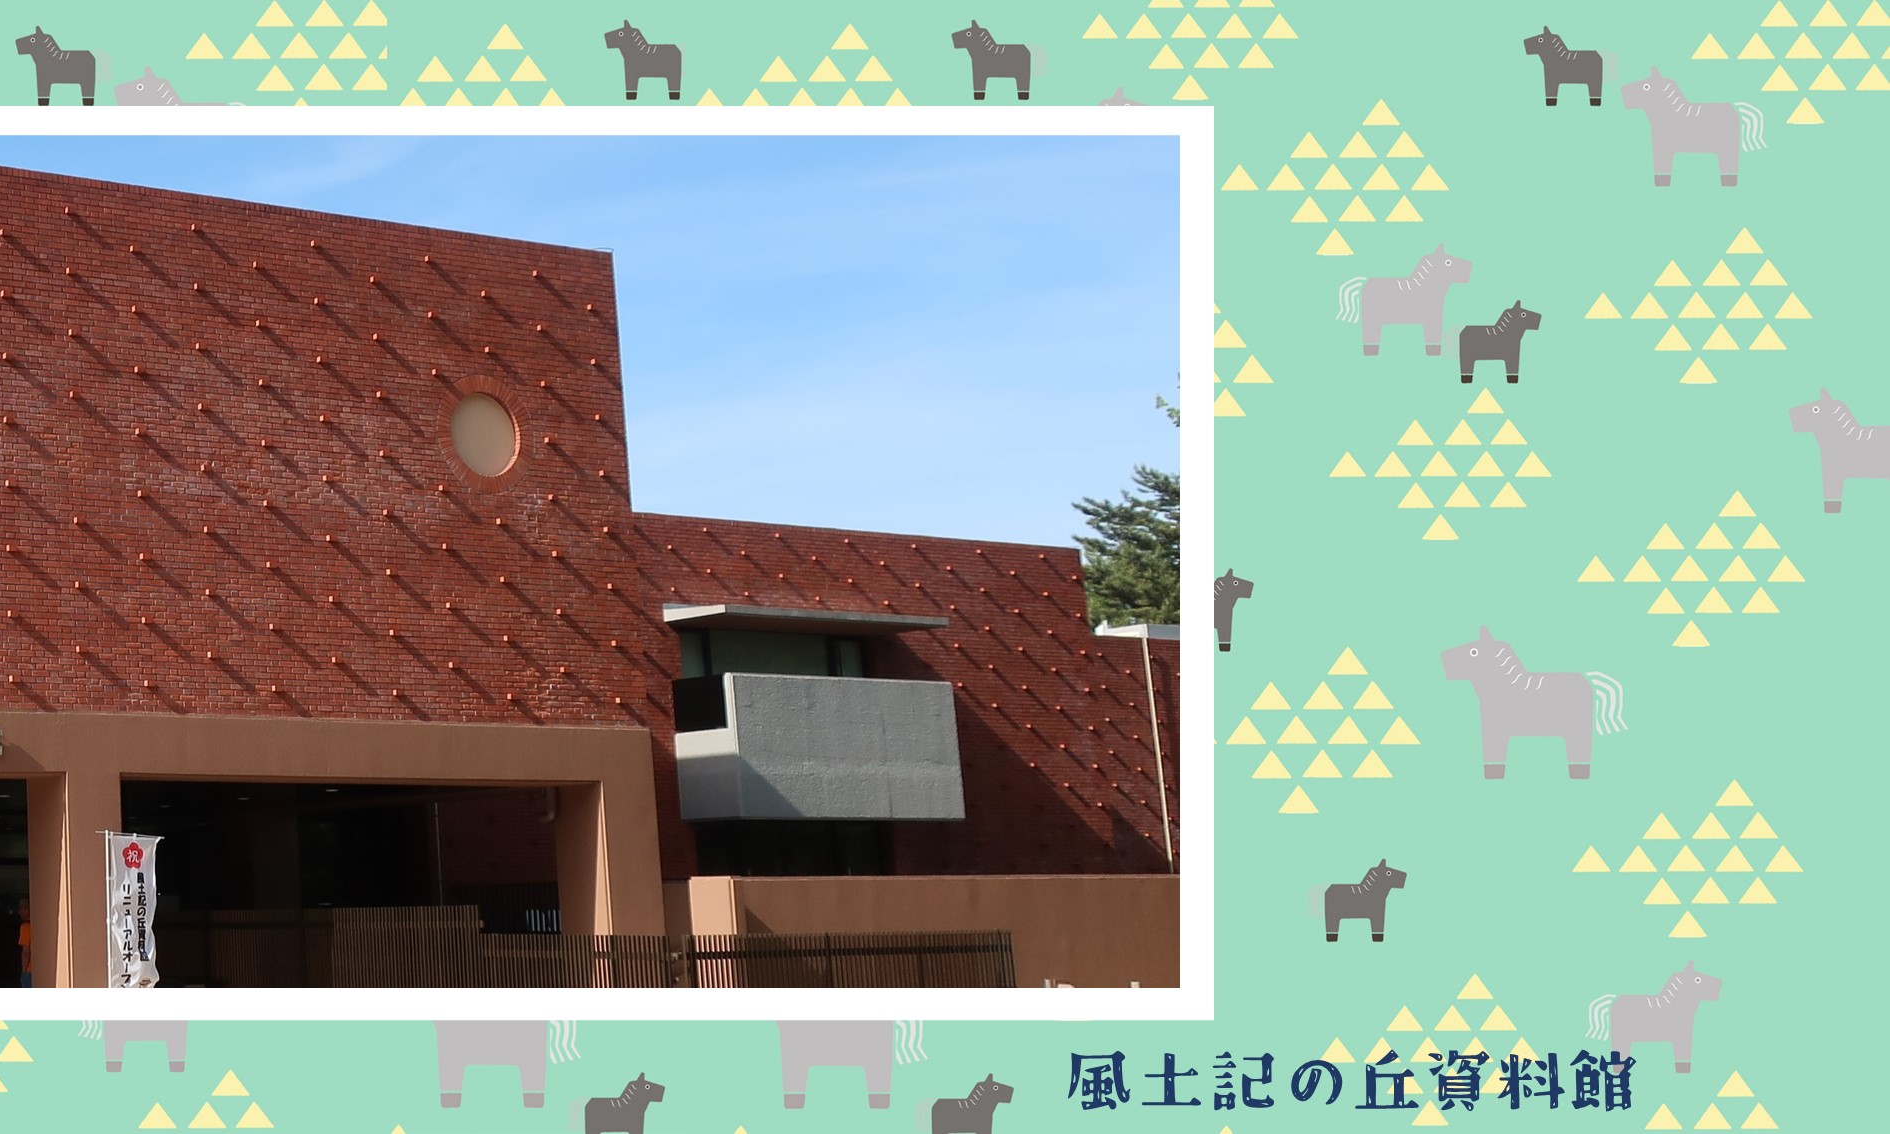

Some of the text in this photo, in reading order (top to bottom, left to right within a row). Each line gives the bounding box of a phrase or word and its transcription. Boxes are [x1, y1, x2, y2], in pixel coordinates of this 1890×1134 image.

[126, 850, 140, 863] 祝
[121, 884, 133, 988] リニューアルオープ
